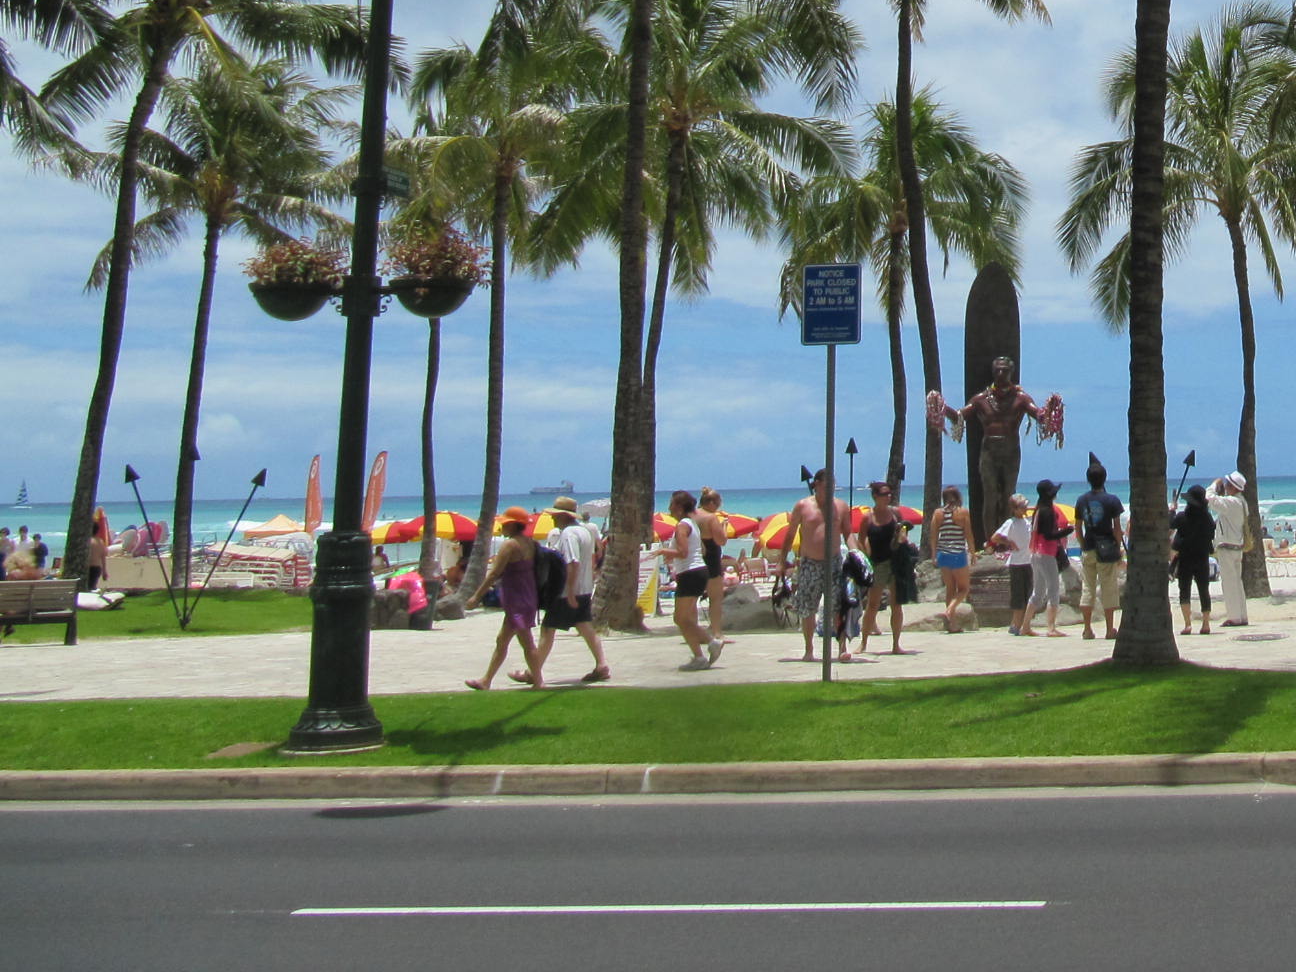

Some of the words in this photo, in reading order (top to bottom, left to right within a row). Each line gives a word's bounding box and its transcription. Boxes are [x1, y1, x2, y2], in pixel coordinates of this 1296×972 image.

[818, 270, 845, 278] NOTICE
[806, 279, 825, 287] PARK
[827, 278, 856, 286] CLOSED
[825, 287, 850, 295] PUBLIC
[816, 296, 826, 305] AM
[844, 295, 855, 304] AM
